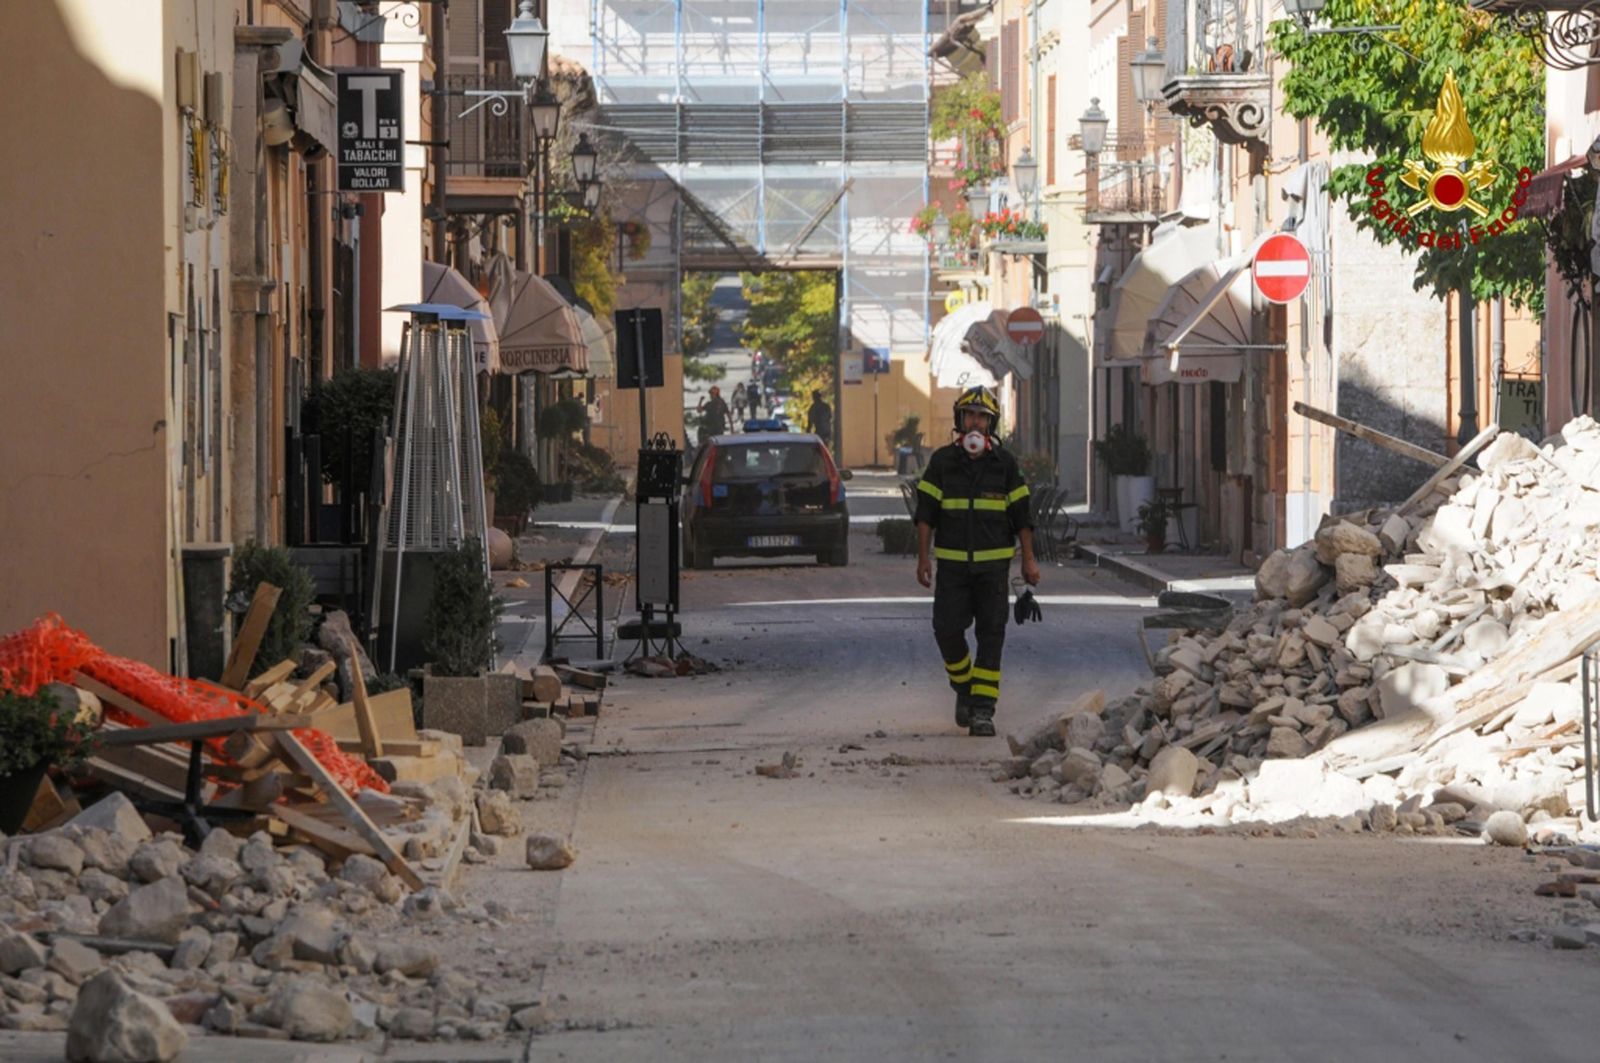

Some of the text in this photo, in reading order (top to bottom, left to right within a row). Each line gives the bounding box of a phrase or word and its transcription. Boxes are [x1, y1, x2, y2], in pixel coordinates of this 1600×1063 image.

[347, 76, 391, 139] T
[355, 141, 384, 149] SALI E
[344, 149, 397, 161] TABACCHI
[354, 167, 387, 177] VALORI
[351, 178, 390, 188] BOLLATI
[500, 348, 572, 367] NORCINERIA
